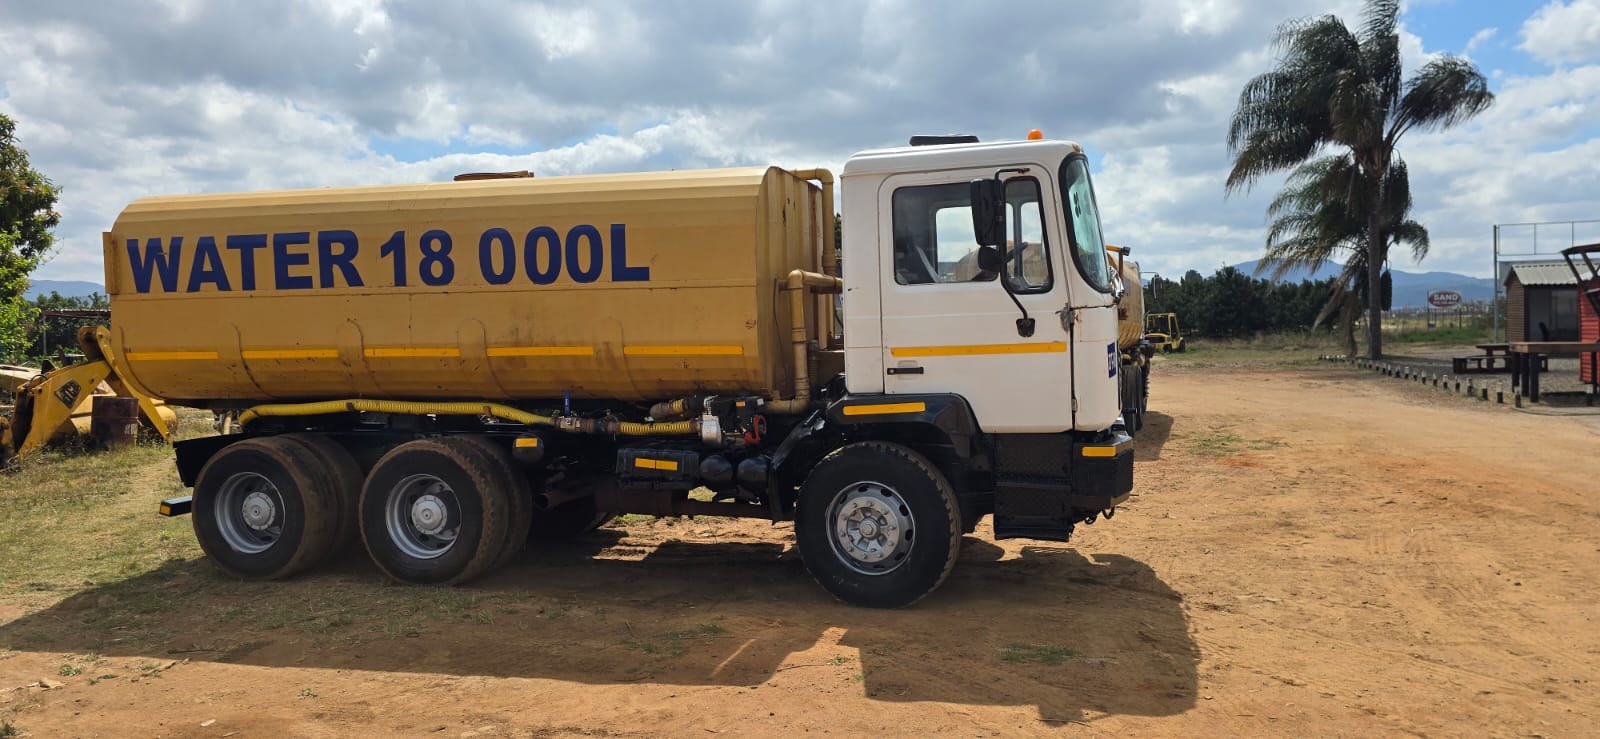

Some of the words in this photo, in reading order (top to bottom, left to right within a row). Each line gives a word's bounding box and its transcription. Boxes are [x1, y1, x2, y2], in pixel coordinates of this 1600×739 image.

[126, 229, 365, 294] WATER
[379, 229, 455, 287] 18
[478, 223, 650, 285] 000L
[1433, 293, 1459, 301] SAND
